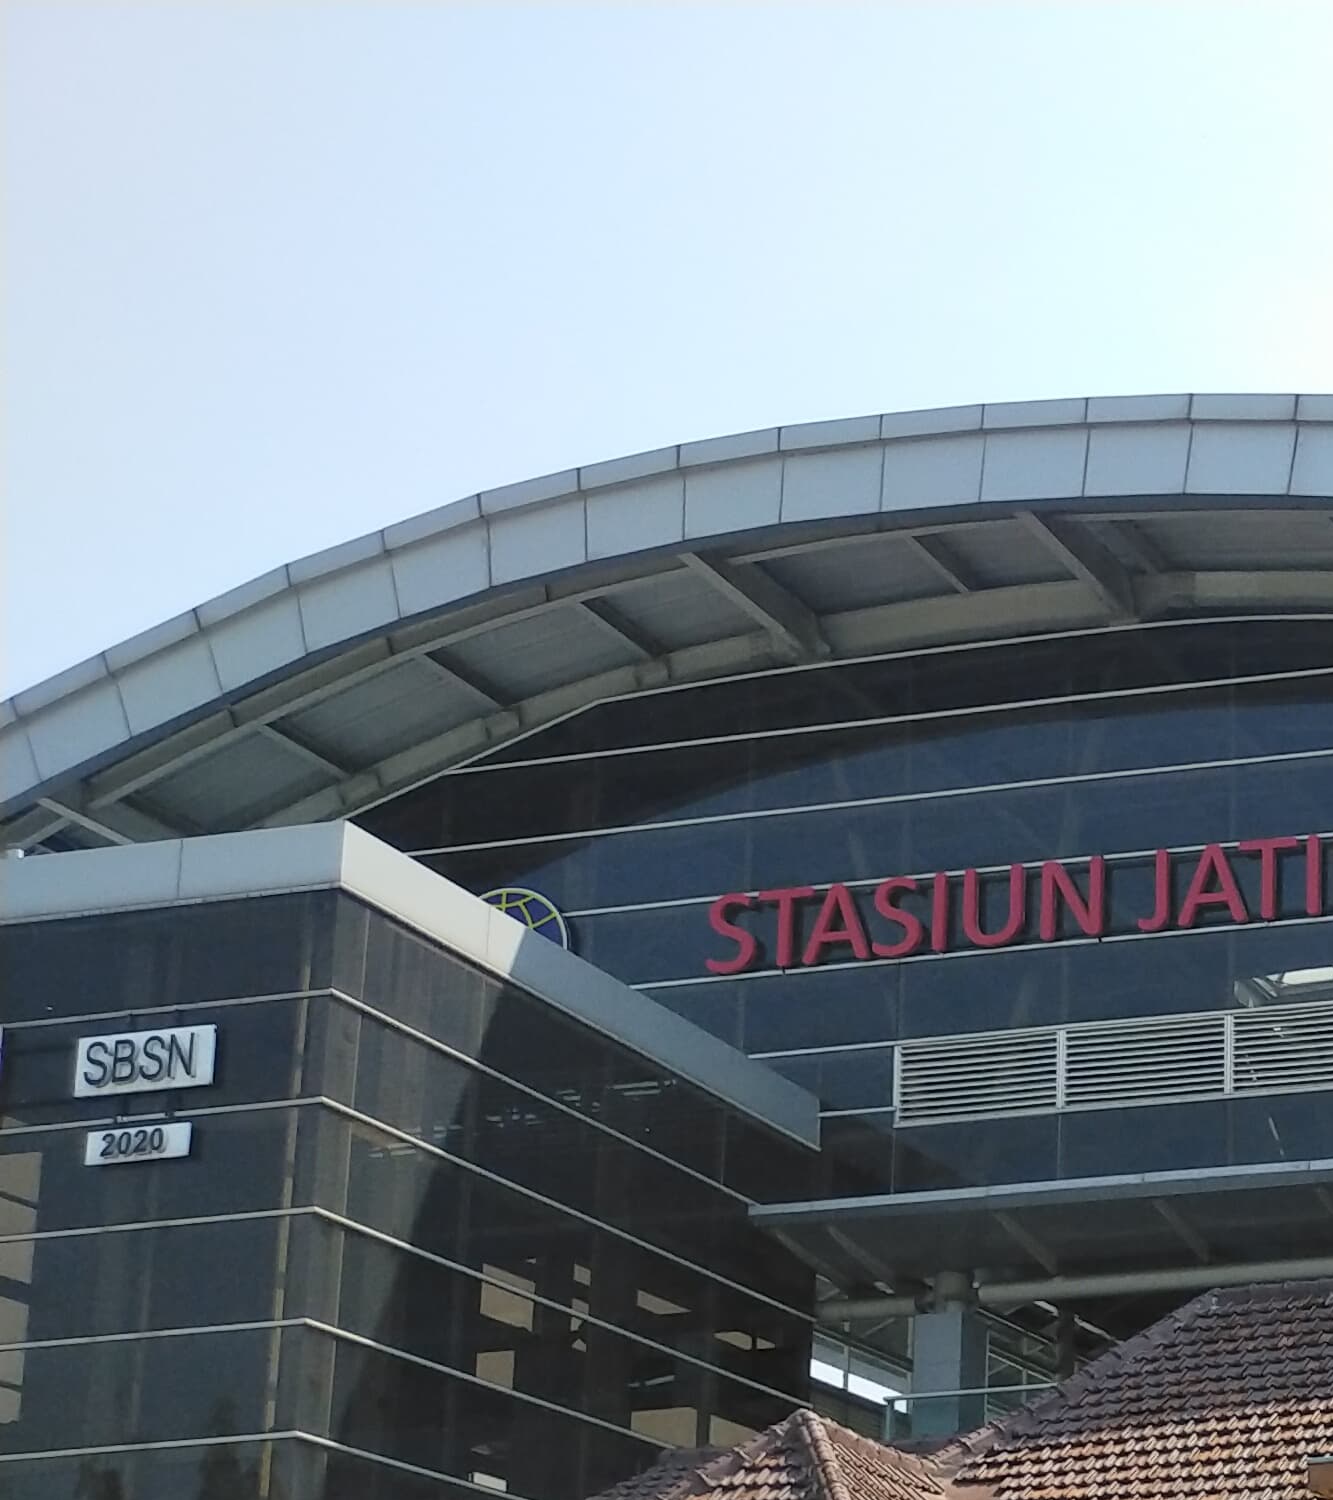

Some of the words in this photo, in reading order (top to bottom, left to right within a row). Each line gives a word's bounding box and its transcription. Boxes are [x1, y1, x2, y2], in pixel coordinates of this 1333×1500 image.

[705, 854, 1105, 975] STASIUN
[83, 1032, 196, 1087] SBSN
[100, 1127, 165, 1158] 2020
